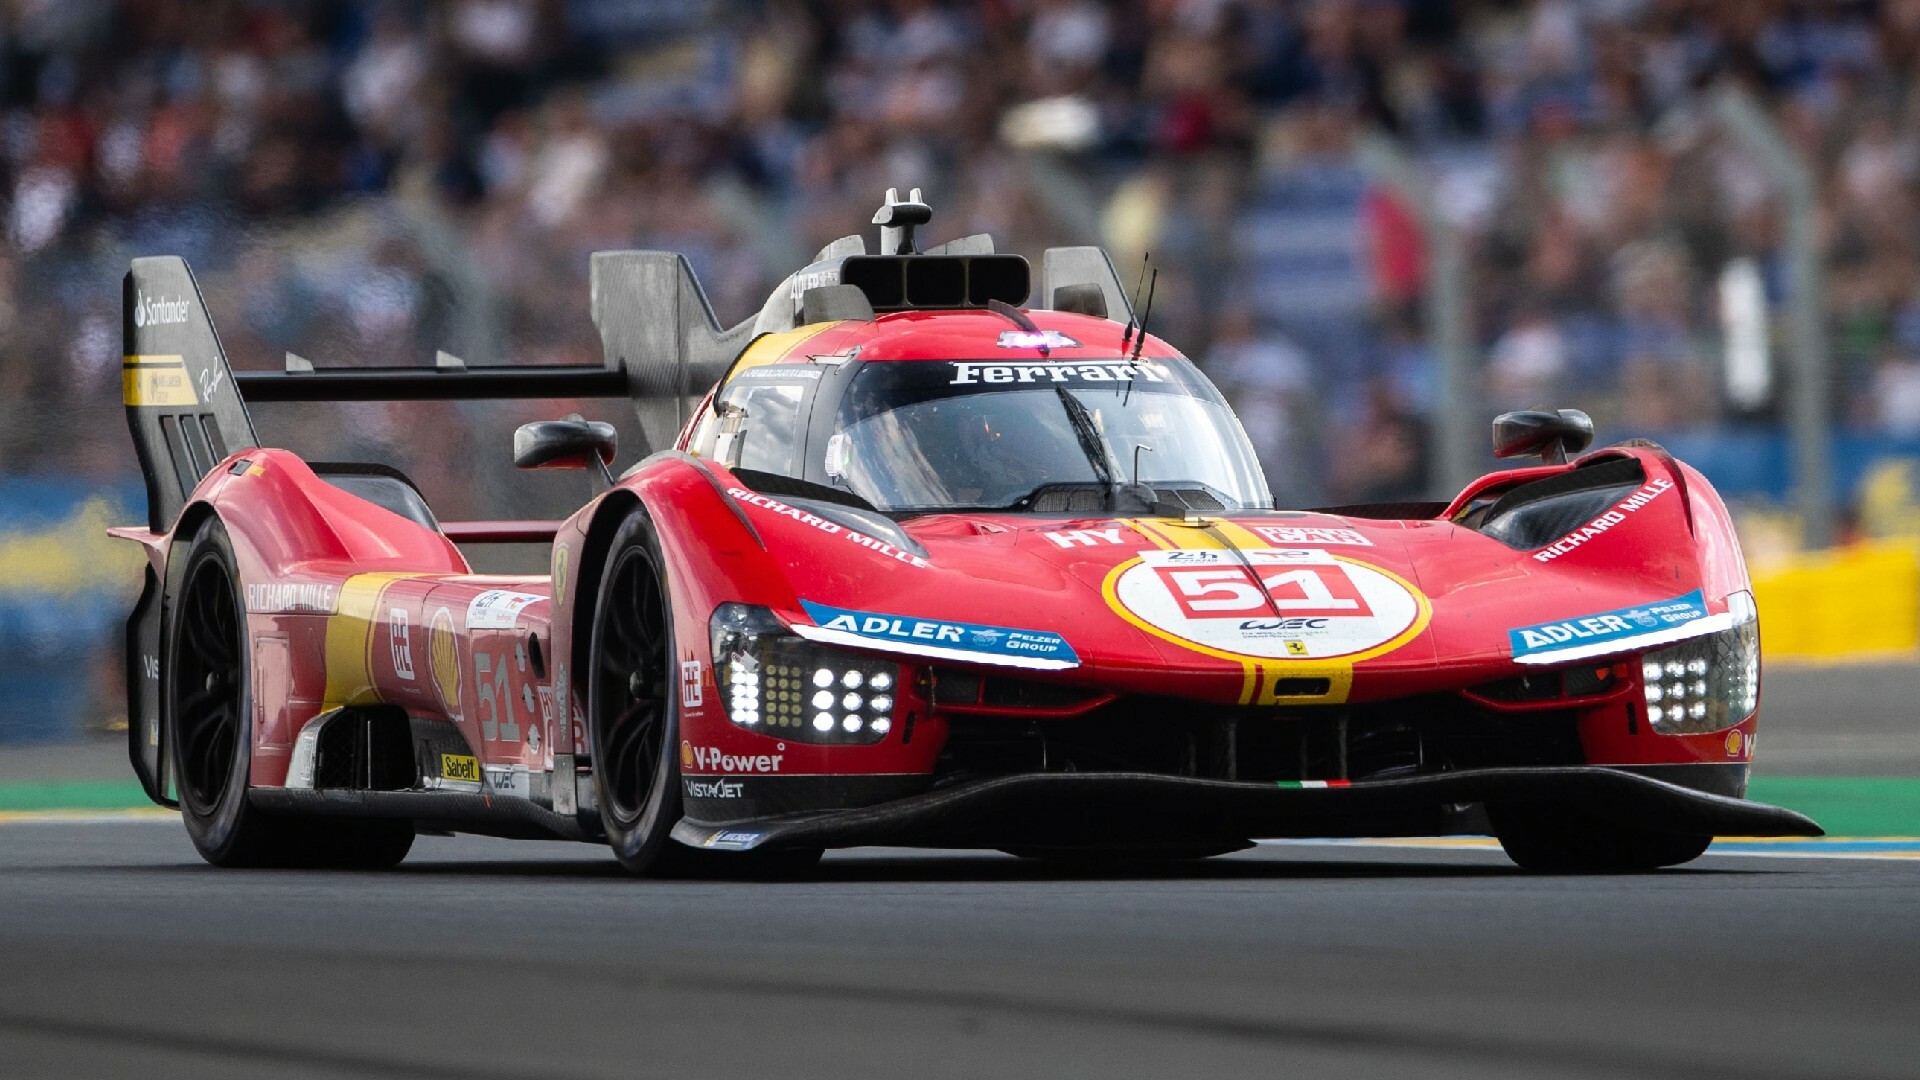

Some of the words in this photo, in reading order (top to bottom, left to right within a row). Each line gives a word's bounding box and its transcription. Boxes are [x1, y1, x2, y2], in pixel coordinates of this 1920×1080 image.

[146, 294, 190, 326] Santander
[950, 360, 1164, 384] Ferrari
[727, 487, 841, 534] RICHARD
[846, 531, 929, 568] MILLE
[1532, 509, 1625, 563] RICHARD
[1620, 477, 1674, 512] MILLE
[1044, 528, 1125, 548] HY
[248, 583, 295, 611] RICHARD
[300, 584, 333, 611] MILLE
[1168, 569, 1360, 611] 51
[1649, 603, 1693, 615] PELZER
[1661, 610, 1702, 623] GROUP
[819, 614, 965, 643] ADLER
[1239, 618, 1330, 630] WEC
[1519, 614, 1633, 649] ADLER
[1006, 640, 1058, 653] GROUP
[1008, 632, 1061, 645] PELZER
[474, 653, 520, 742] 51
[445, 756, 475, 778] Sabelt
[693, 746, 783, 772] V-Power
